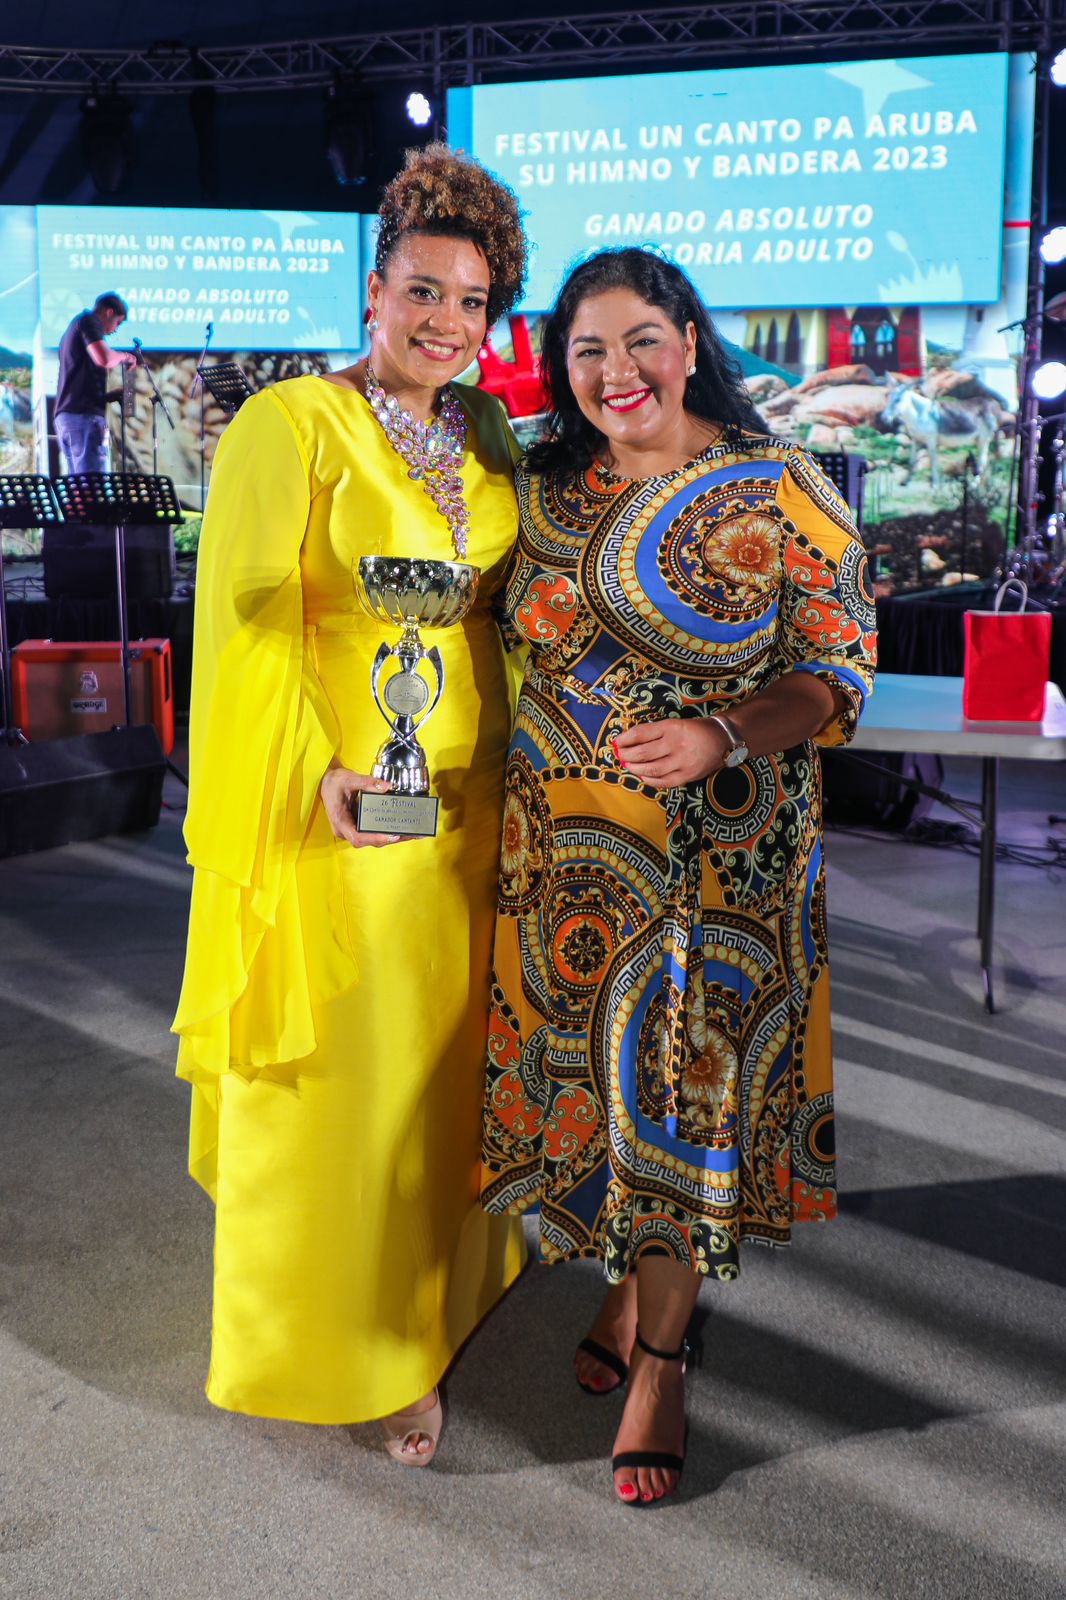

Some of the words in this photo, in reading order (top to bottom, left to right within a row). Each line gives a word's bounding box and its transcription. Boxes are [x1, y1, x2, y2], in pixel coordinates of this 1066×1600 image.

[495, 128, 628, 156] FESTIVAL
[638, 124, 683, 148] UN
[695, 117, 802, 146] CANTO
[814, 115, 855, 141] PA
[865, 109, 978, 138] ARUBA
[519, 163, 555, 187] SU
[567, 157, 672, 185] HIMNO
[683, 155, 702, 179] Y
[712, 148, 862, 178] BANDERA
[872, 145, 949, 172] 2023
[584, 209, 706, 236] GANADO
[714, 204, 874, 232] ABSOLUTO
[52, 233, 139, 250] FESTIVAL
[146, 235, 174, 251] UN
[181, 235, 246, 252] CANTO
[252, 237, 276, 252] PA
[281, 238, 345, 254] ARUBA
[752, 237, 874, 264] ADULTO
[69, 253, 95, 270] SU
[101, 254, 169, 270] HIMNO
[174, 255, 187, 270] Y
[192, 256, 282, 272] BANDERA
[286, 257, 330, 272] 2023
[196, 288, 289, 304] ABSOLUTO
[127, 307, 214, 323] ATEGORIA
[219, 308, 290, 323] ADULTO
